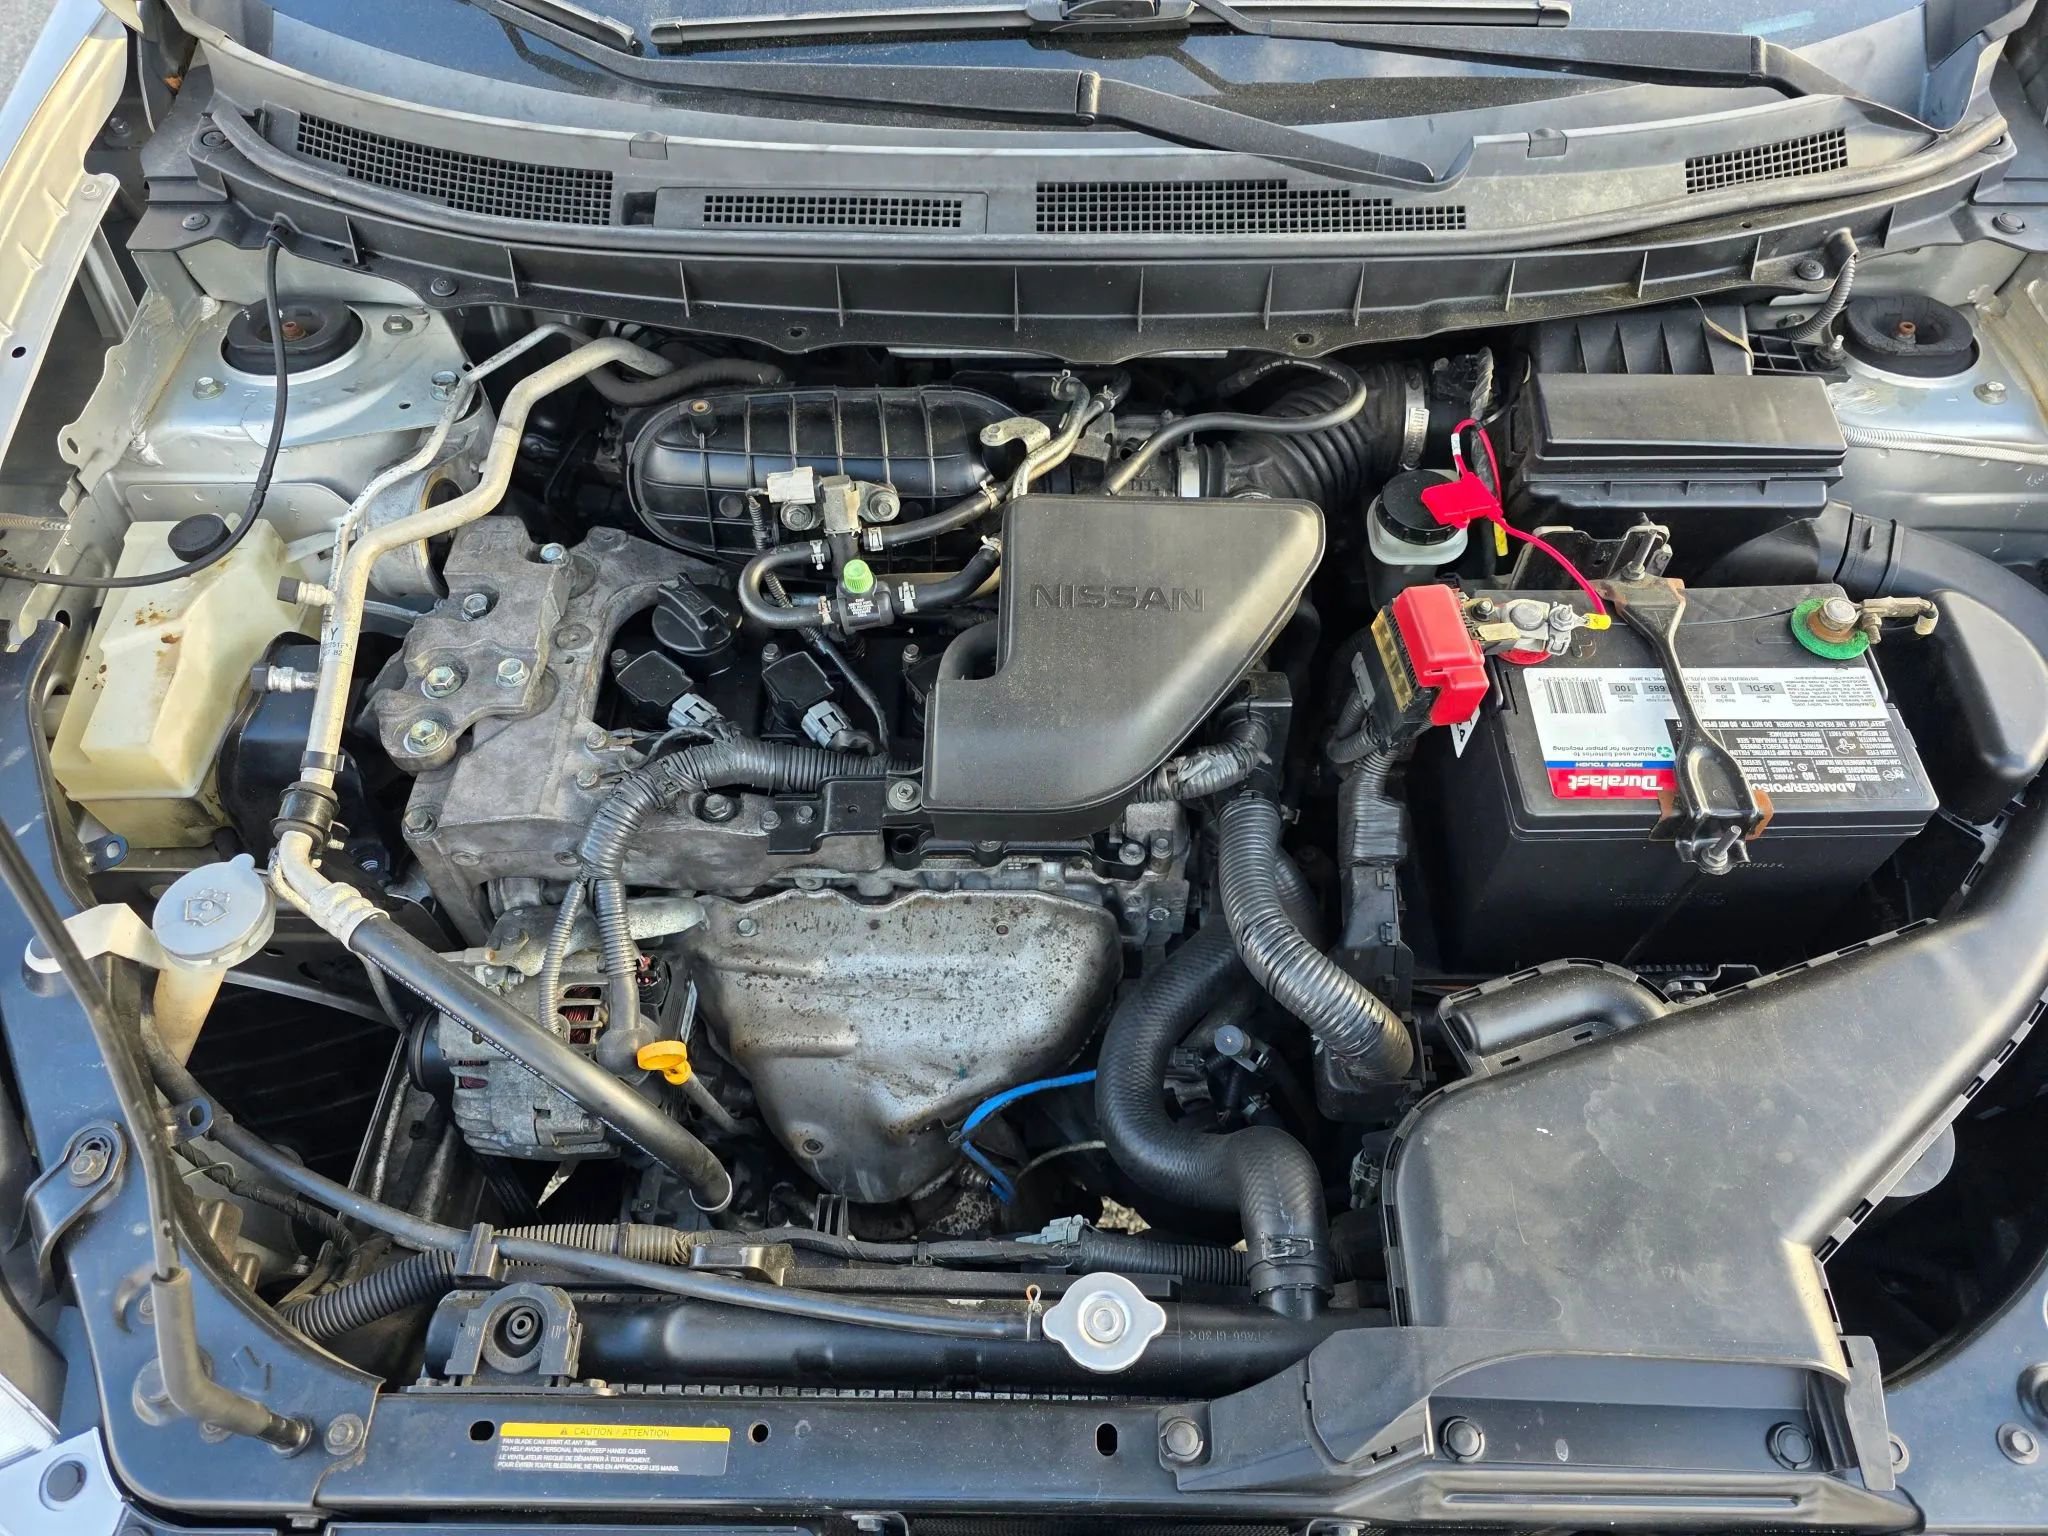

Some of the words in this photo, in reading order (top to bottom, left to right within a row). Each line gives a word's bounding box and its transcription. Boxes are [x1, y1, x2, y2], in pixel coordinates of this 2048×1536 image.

[1029, 583, 1205, 612] NISSAN
[1715, 684, 1727, 692] 35
[1746, 684, 1776, 692] 35-DL
[1802, 772, 1816, 780] NO
[1844, 774, 1860, 782] EYES
[1568, 774, 1664, 791] Duralast
[1751, 782, 1847, 793] DANGER/POISO
[405, 982, 425, 996] JAPAN
[434, 1001, 451, 1016] MADE
[574, 1428, 612, 1436] CAUTION
[622, 1428, 669, 1437] ATTENTION
